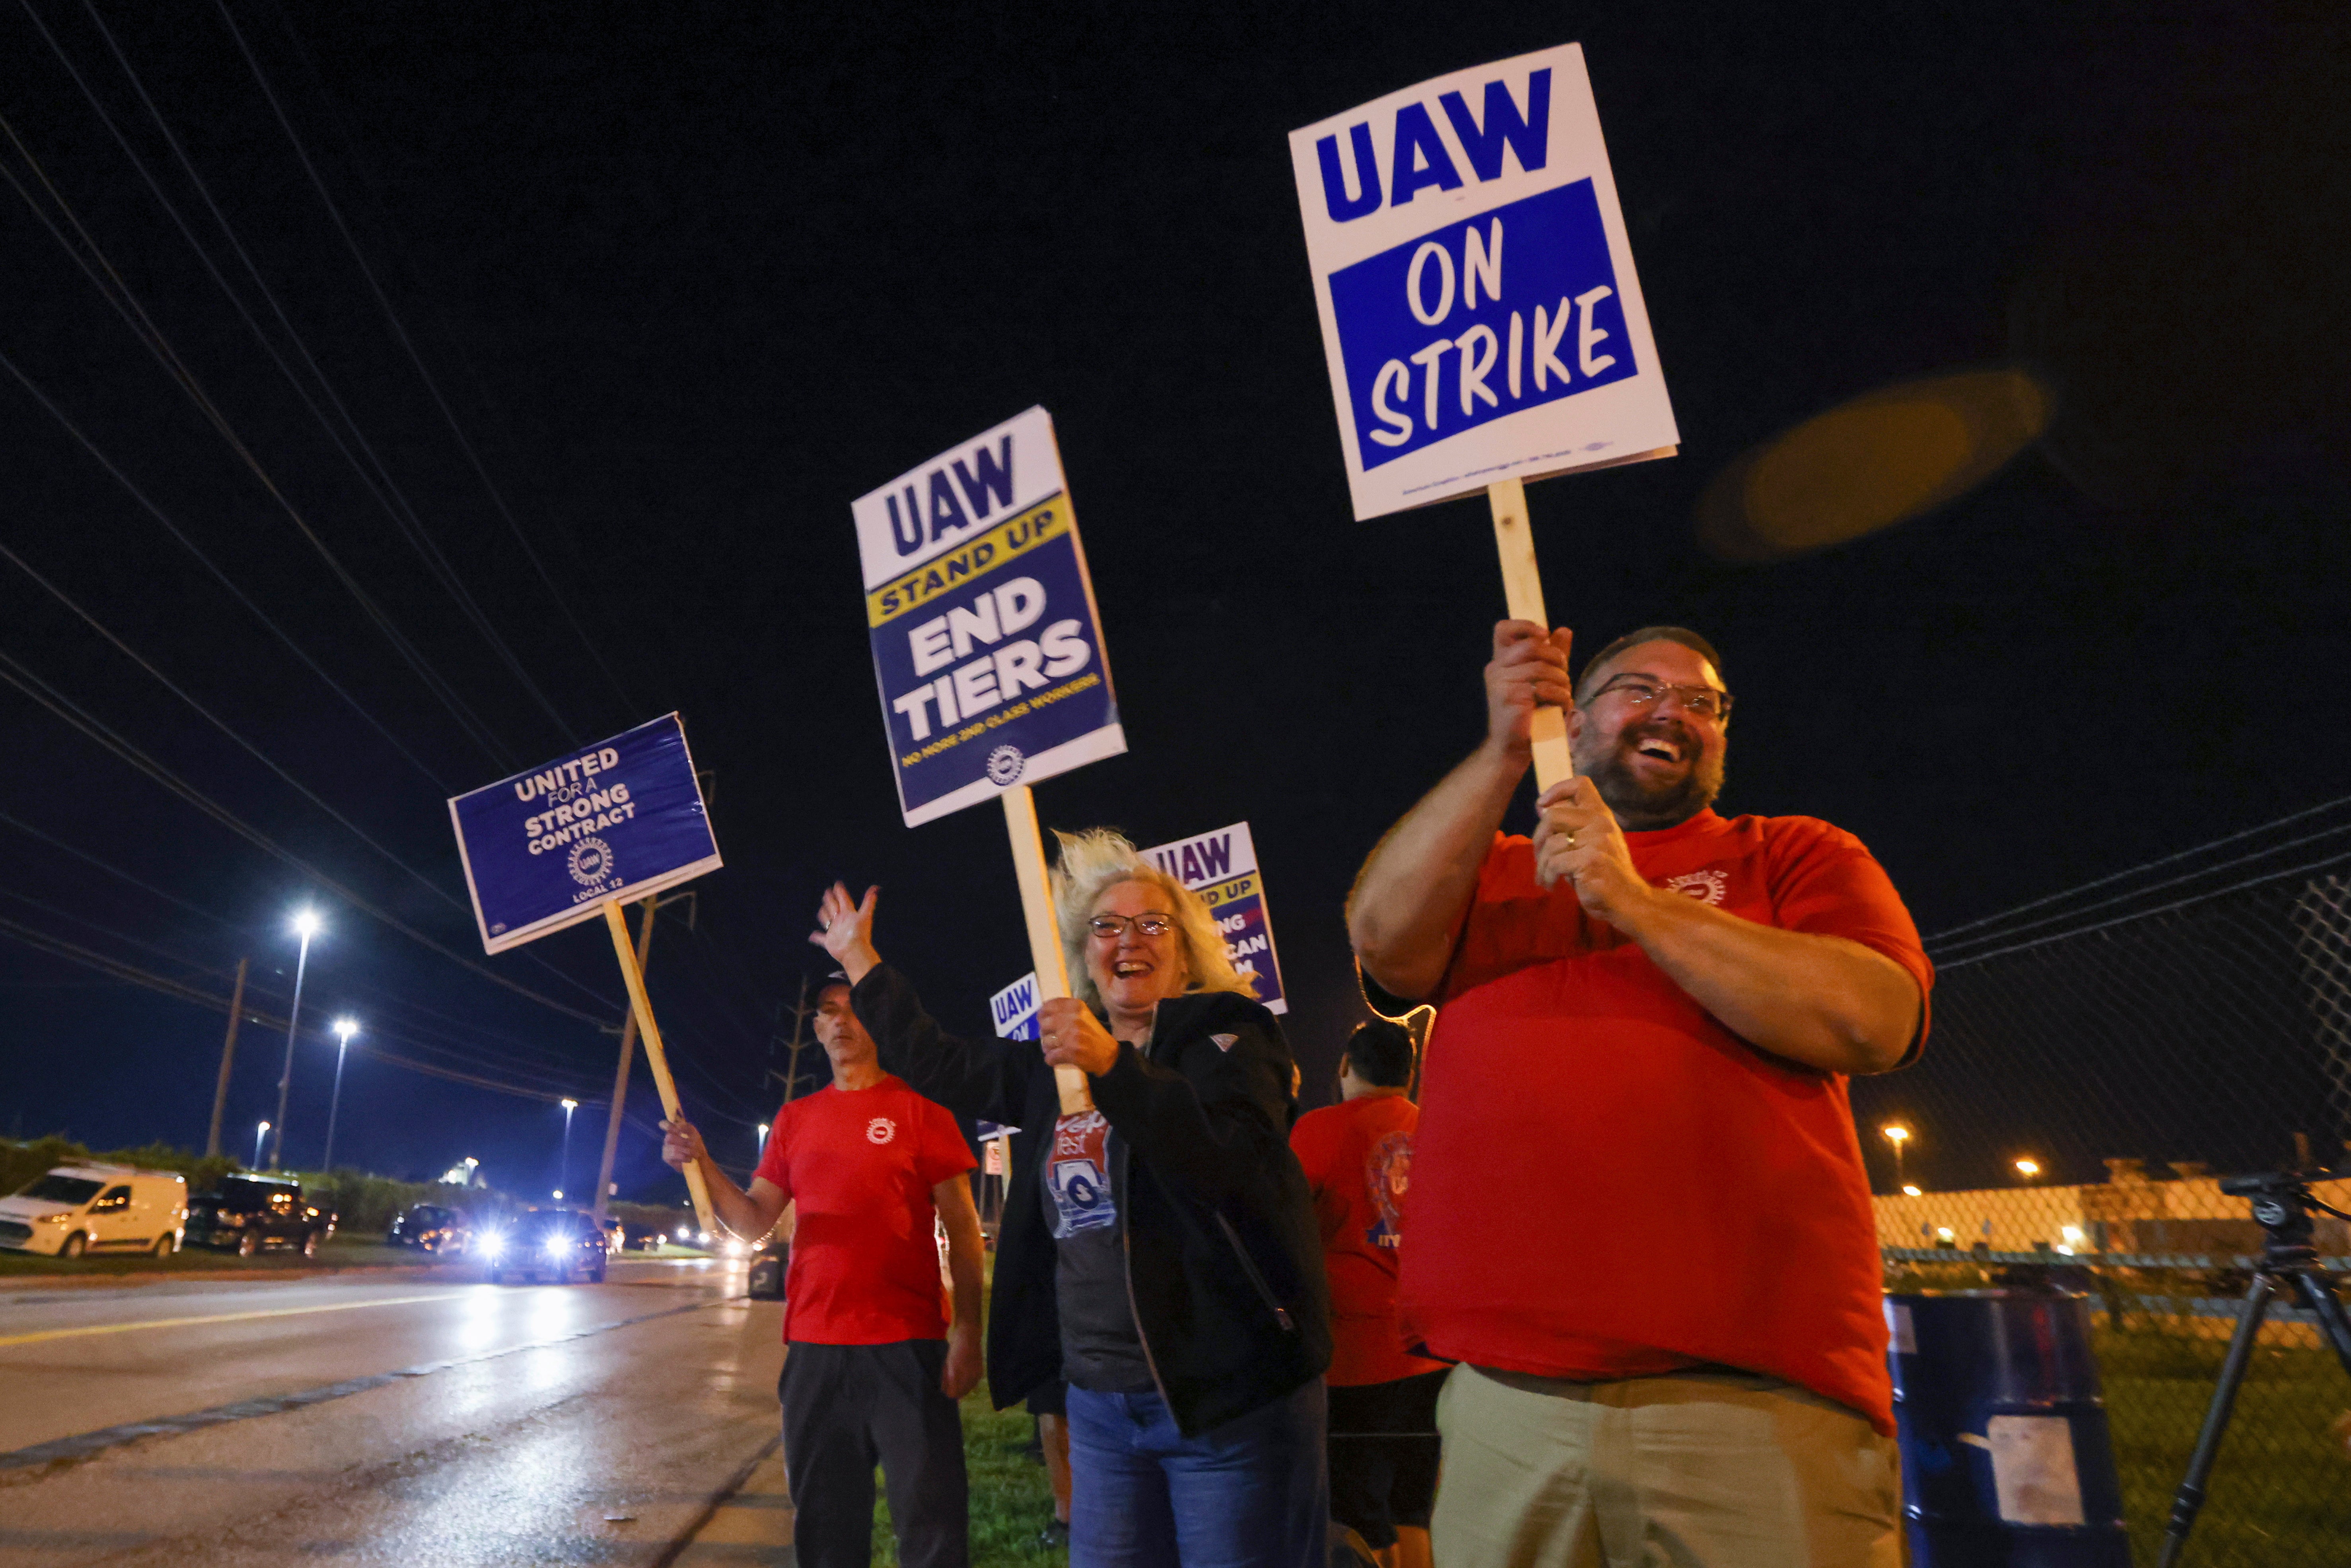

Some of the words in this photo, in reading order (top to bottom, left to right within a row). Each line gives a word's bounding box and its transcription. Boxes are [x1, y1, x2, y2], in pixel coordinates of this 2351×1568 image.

[1316, 68, 1551, 223] UAW
[1407, 217, 1502, 325] ON
[1369, 285, 1615, 447] STRIKE
[886, 433, 1015, 556] UAW
[880, 542, 995, 615] STAND
[1006, 510, 1055, 548] UP
[908, 576, 1046, 677] END
[893, 619, 1091, 741] TIERS
[902, 752, 922, 767] NO
[921, 734, 959, 758] MORE
[985, 702, 1030, 728] CLASS
[1029, 673, 1100, 709] WORKERS
[515, 747, 619, 802] UNITED
[525, 783, 630, 837] STRONG
[547, 781, 582, 807] FOR
[586, 777, 597, 794] A
[528, 802, 635, 855] CONTRACT
[1156, 833, 1230, 885] UAW
[573, 885, 609, 903] LOCAL
[609, 877, 623, 889] 12
[1225, 880, 1251, 898] UP
[996, 979, 1031, 1024] UAW
